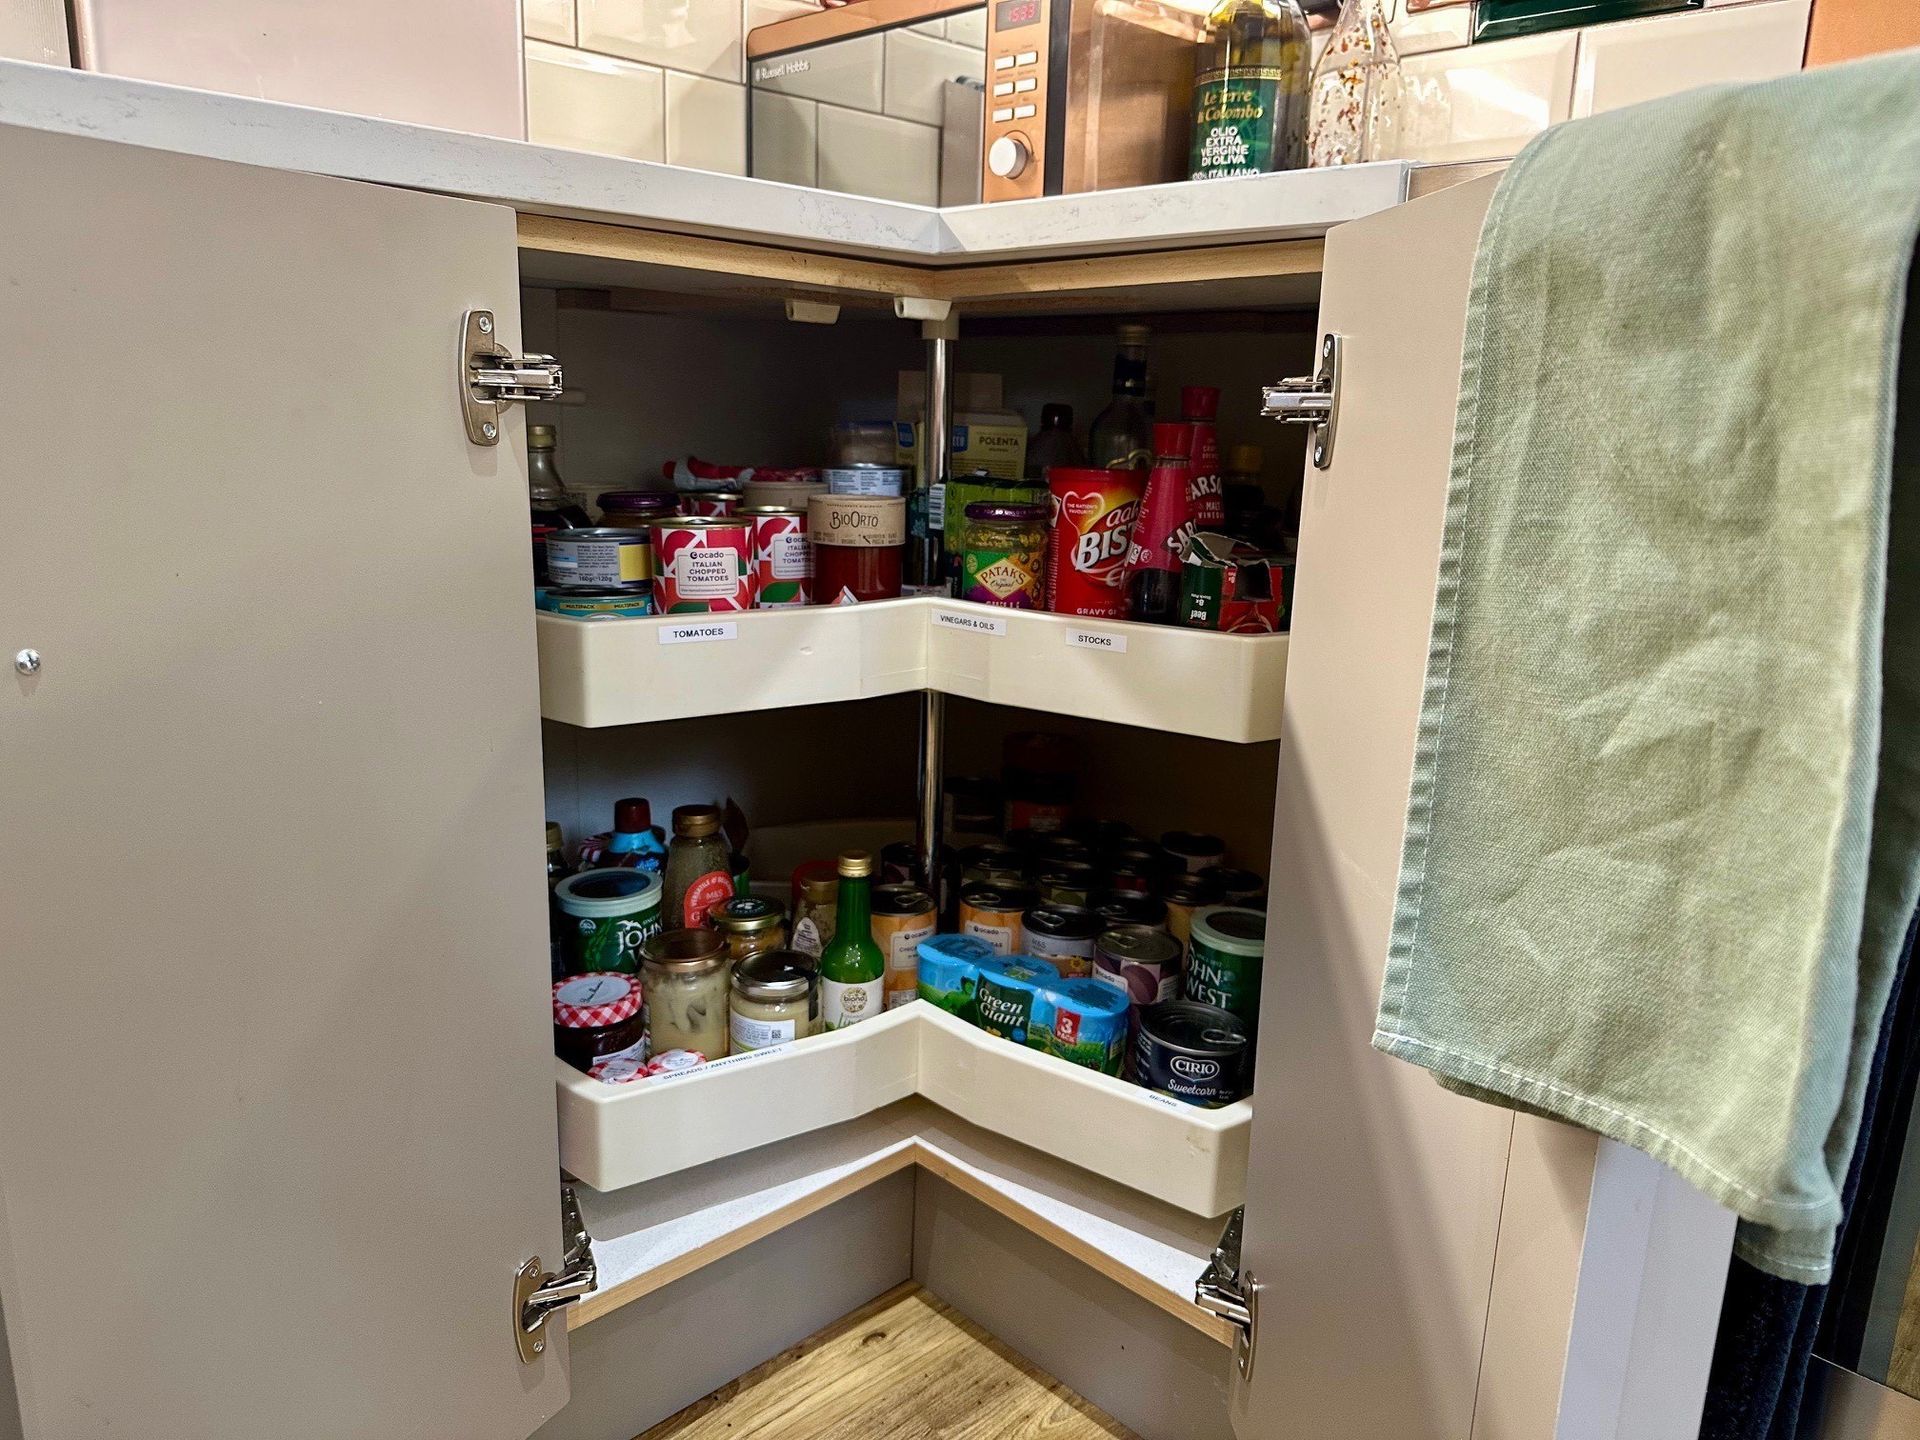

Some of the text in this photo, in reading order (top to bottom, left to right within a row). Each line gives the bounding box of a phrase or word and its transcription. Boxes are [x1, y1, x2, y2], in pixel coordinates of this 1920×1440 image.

[761, 60, 810, 80] Russell Hobbs
[1204, 89, 1254, 106] Le Terre
[1205, 104, 1263, 121] Colombo
[1210, 127, 1238, 137] OLIO
[1205, 136, 1242, 148] EXTRA
[1200, 145, 1249, 158] VERGINE
[1201, 155, 1245, 166] DI OLIVA
[1208, 168, 1259, 179] ITALIANO
[979, 437, 1018, 446] POLENTA
[699, 551, 724, 559] ocado
[1076, 607, 1106, 615] GRAVY
[1190, 610, 1207, 620] Beef
[940, 614, 971, 627] VINEGARS
[979, 621, 995, 630] OILS
[673, 628, 724, 638] TOMATOES
[1078, 634, 1112, 645] STOCKS
[617, 922, 662, 956] JOHN
[1187, 953, 1222, 987] OHN
[1187, 976, 1232, 1009] WEST
[979, 988, 1024, 1014] Green
[980, 1002, 1025, 1026] Giant
[1061, 1017, 1074, 1034] 3
[1056, 1031, 1077, 1044] PACK
[663, 1066, 703, 1080] SPREADS
[710, 1055, 752, 1069] ANYTHING
[754, 1047, 782, 1058] SWEET
[1175, 1061, 1216, 1075] CIRIO
[1167, 1078, 1217, 1096] Sweetcorn
